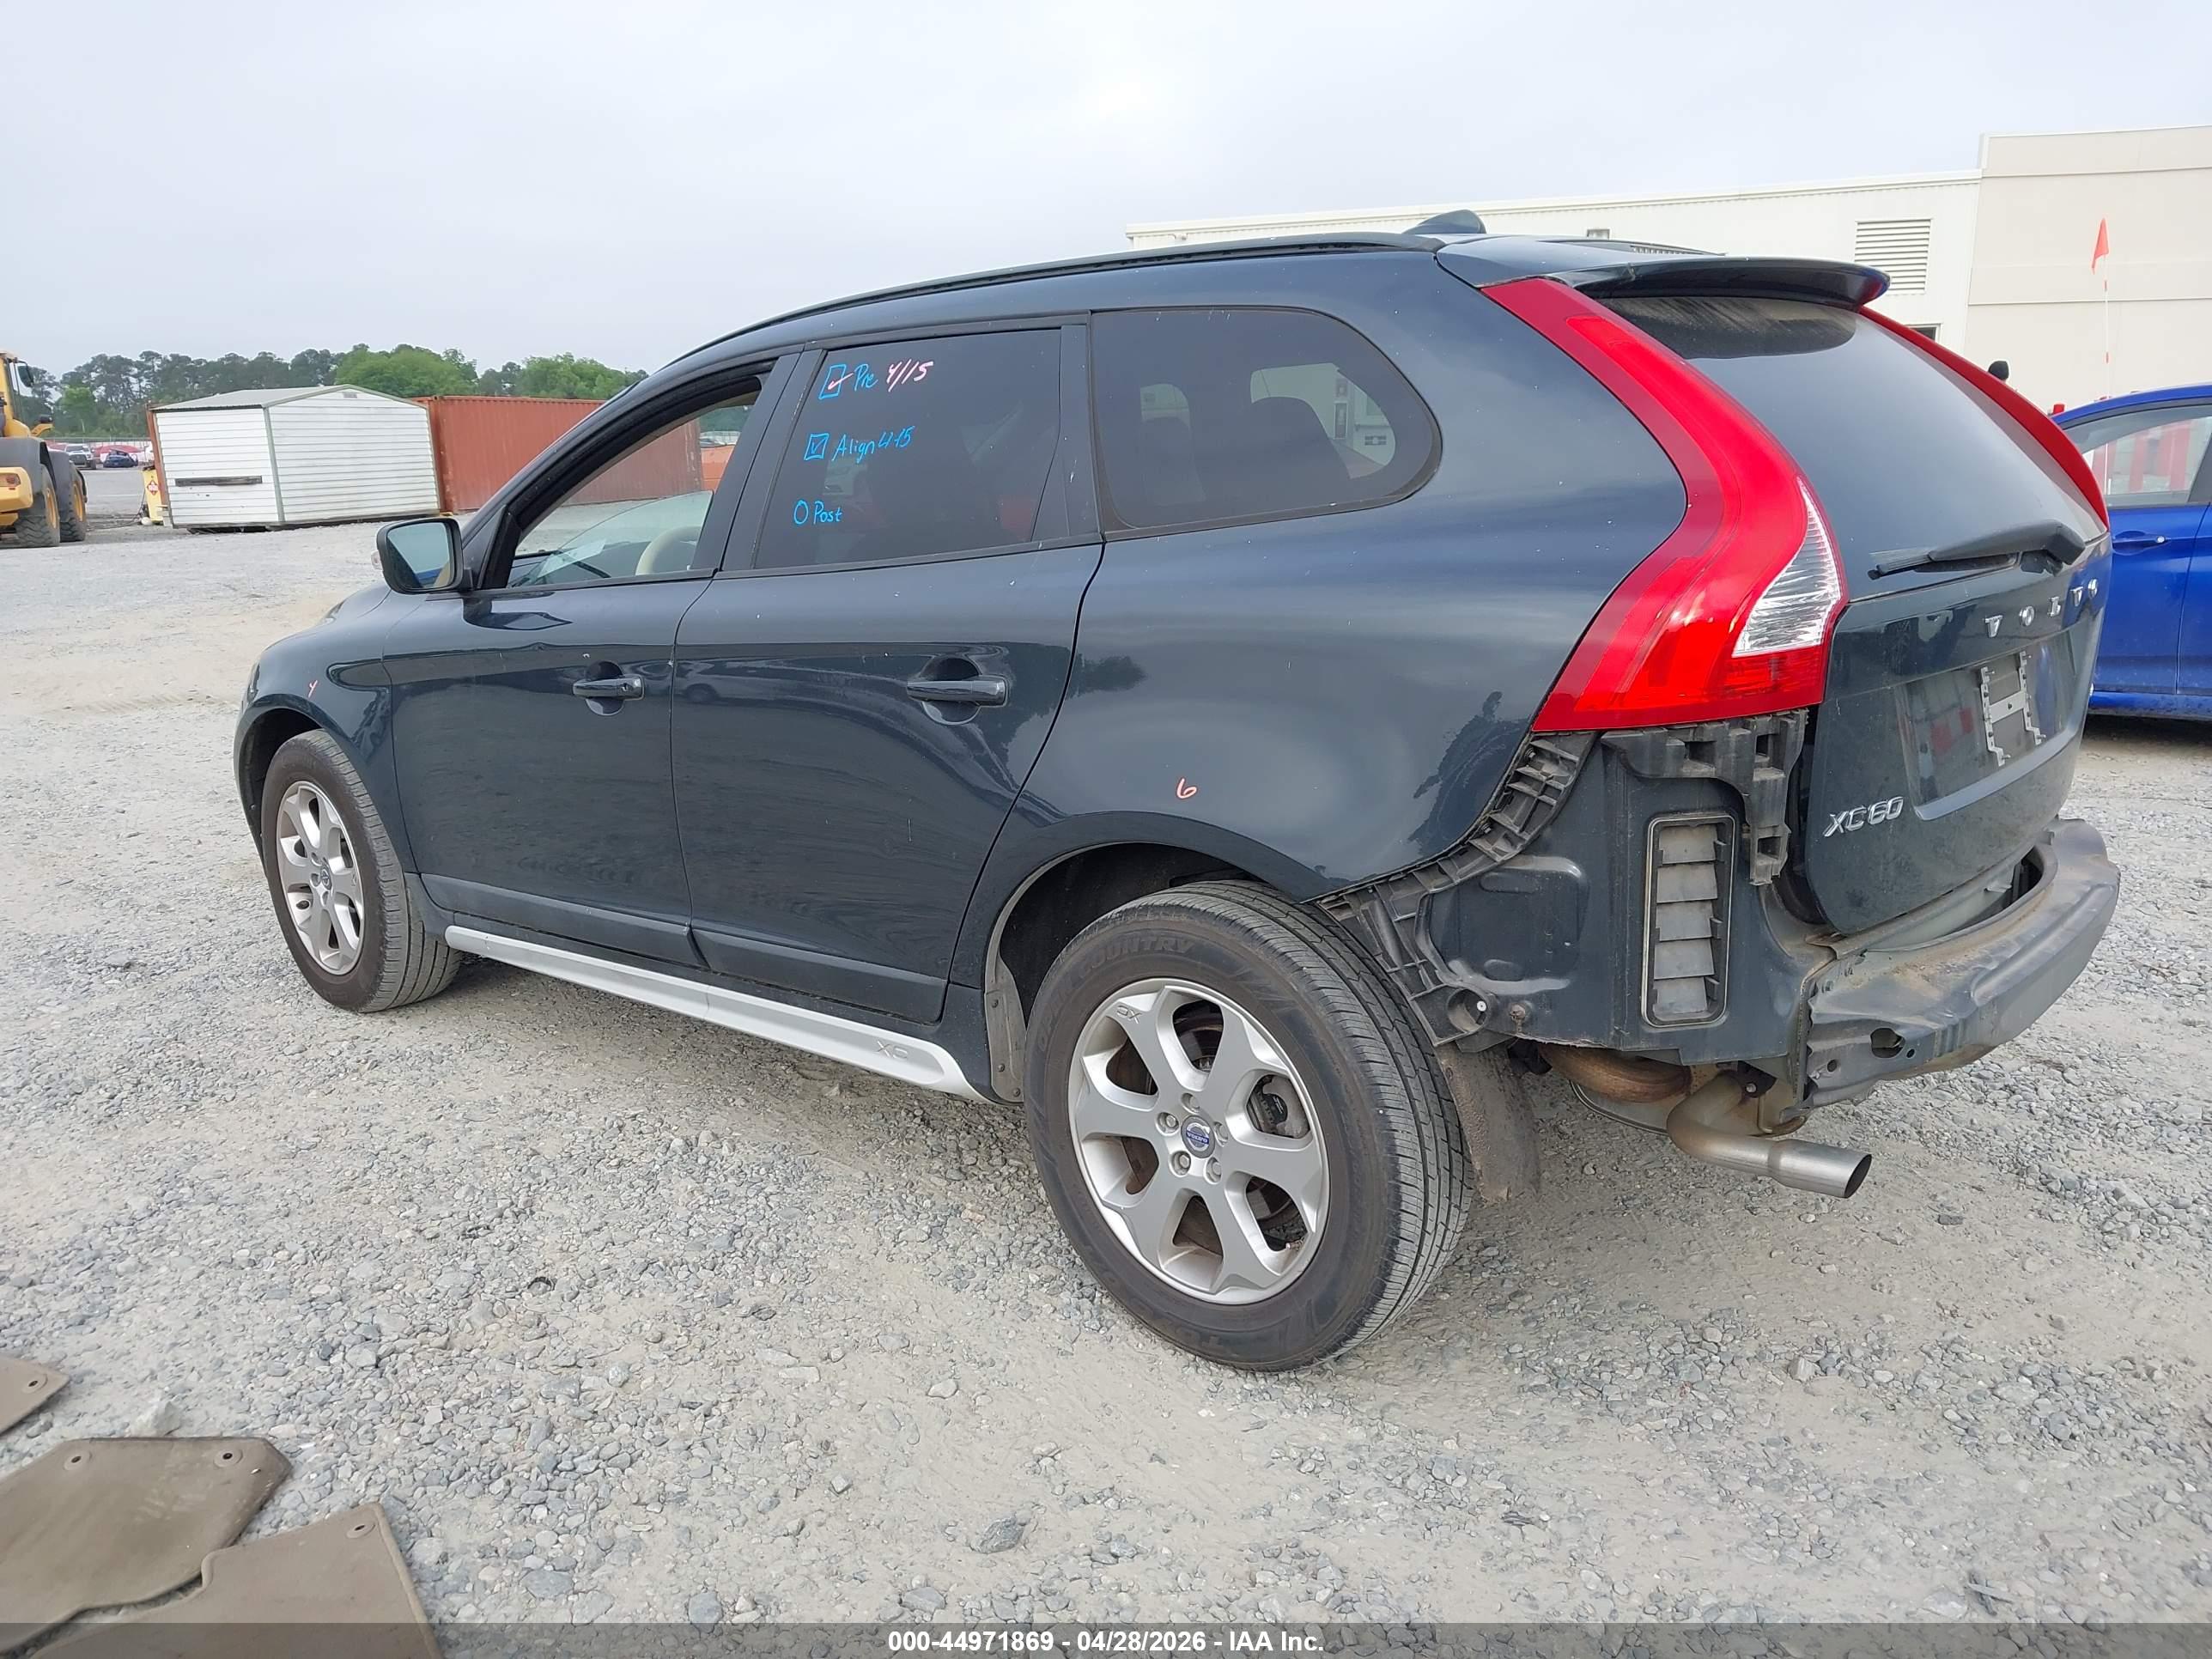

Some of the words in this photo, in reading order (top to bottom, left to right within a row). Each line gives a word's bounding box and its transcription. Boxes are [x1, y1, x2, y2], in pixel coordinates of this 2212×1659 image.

[854, 363, 878, 392] Pre
[885, 359, 934, 392] 4/15
[831, 433, 875, 465] Align
[813, 501, 842, 525] Post
[1984, 578, 2100, 638] VOLVO
[1176, 777, 1198, 799] 6
[1822, 795, 1904, 837] XC60
